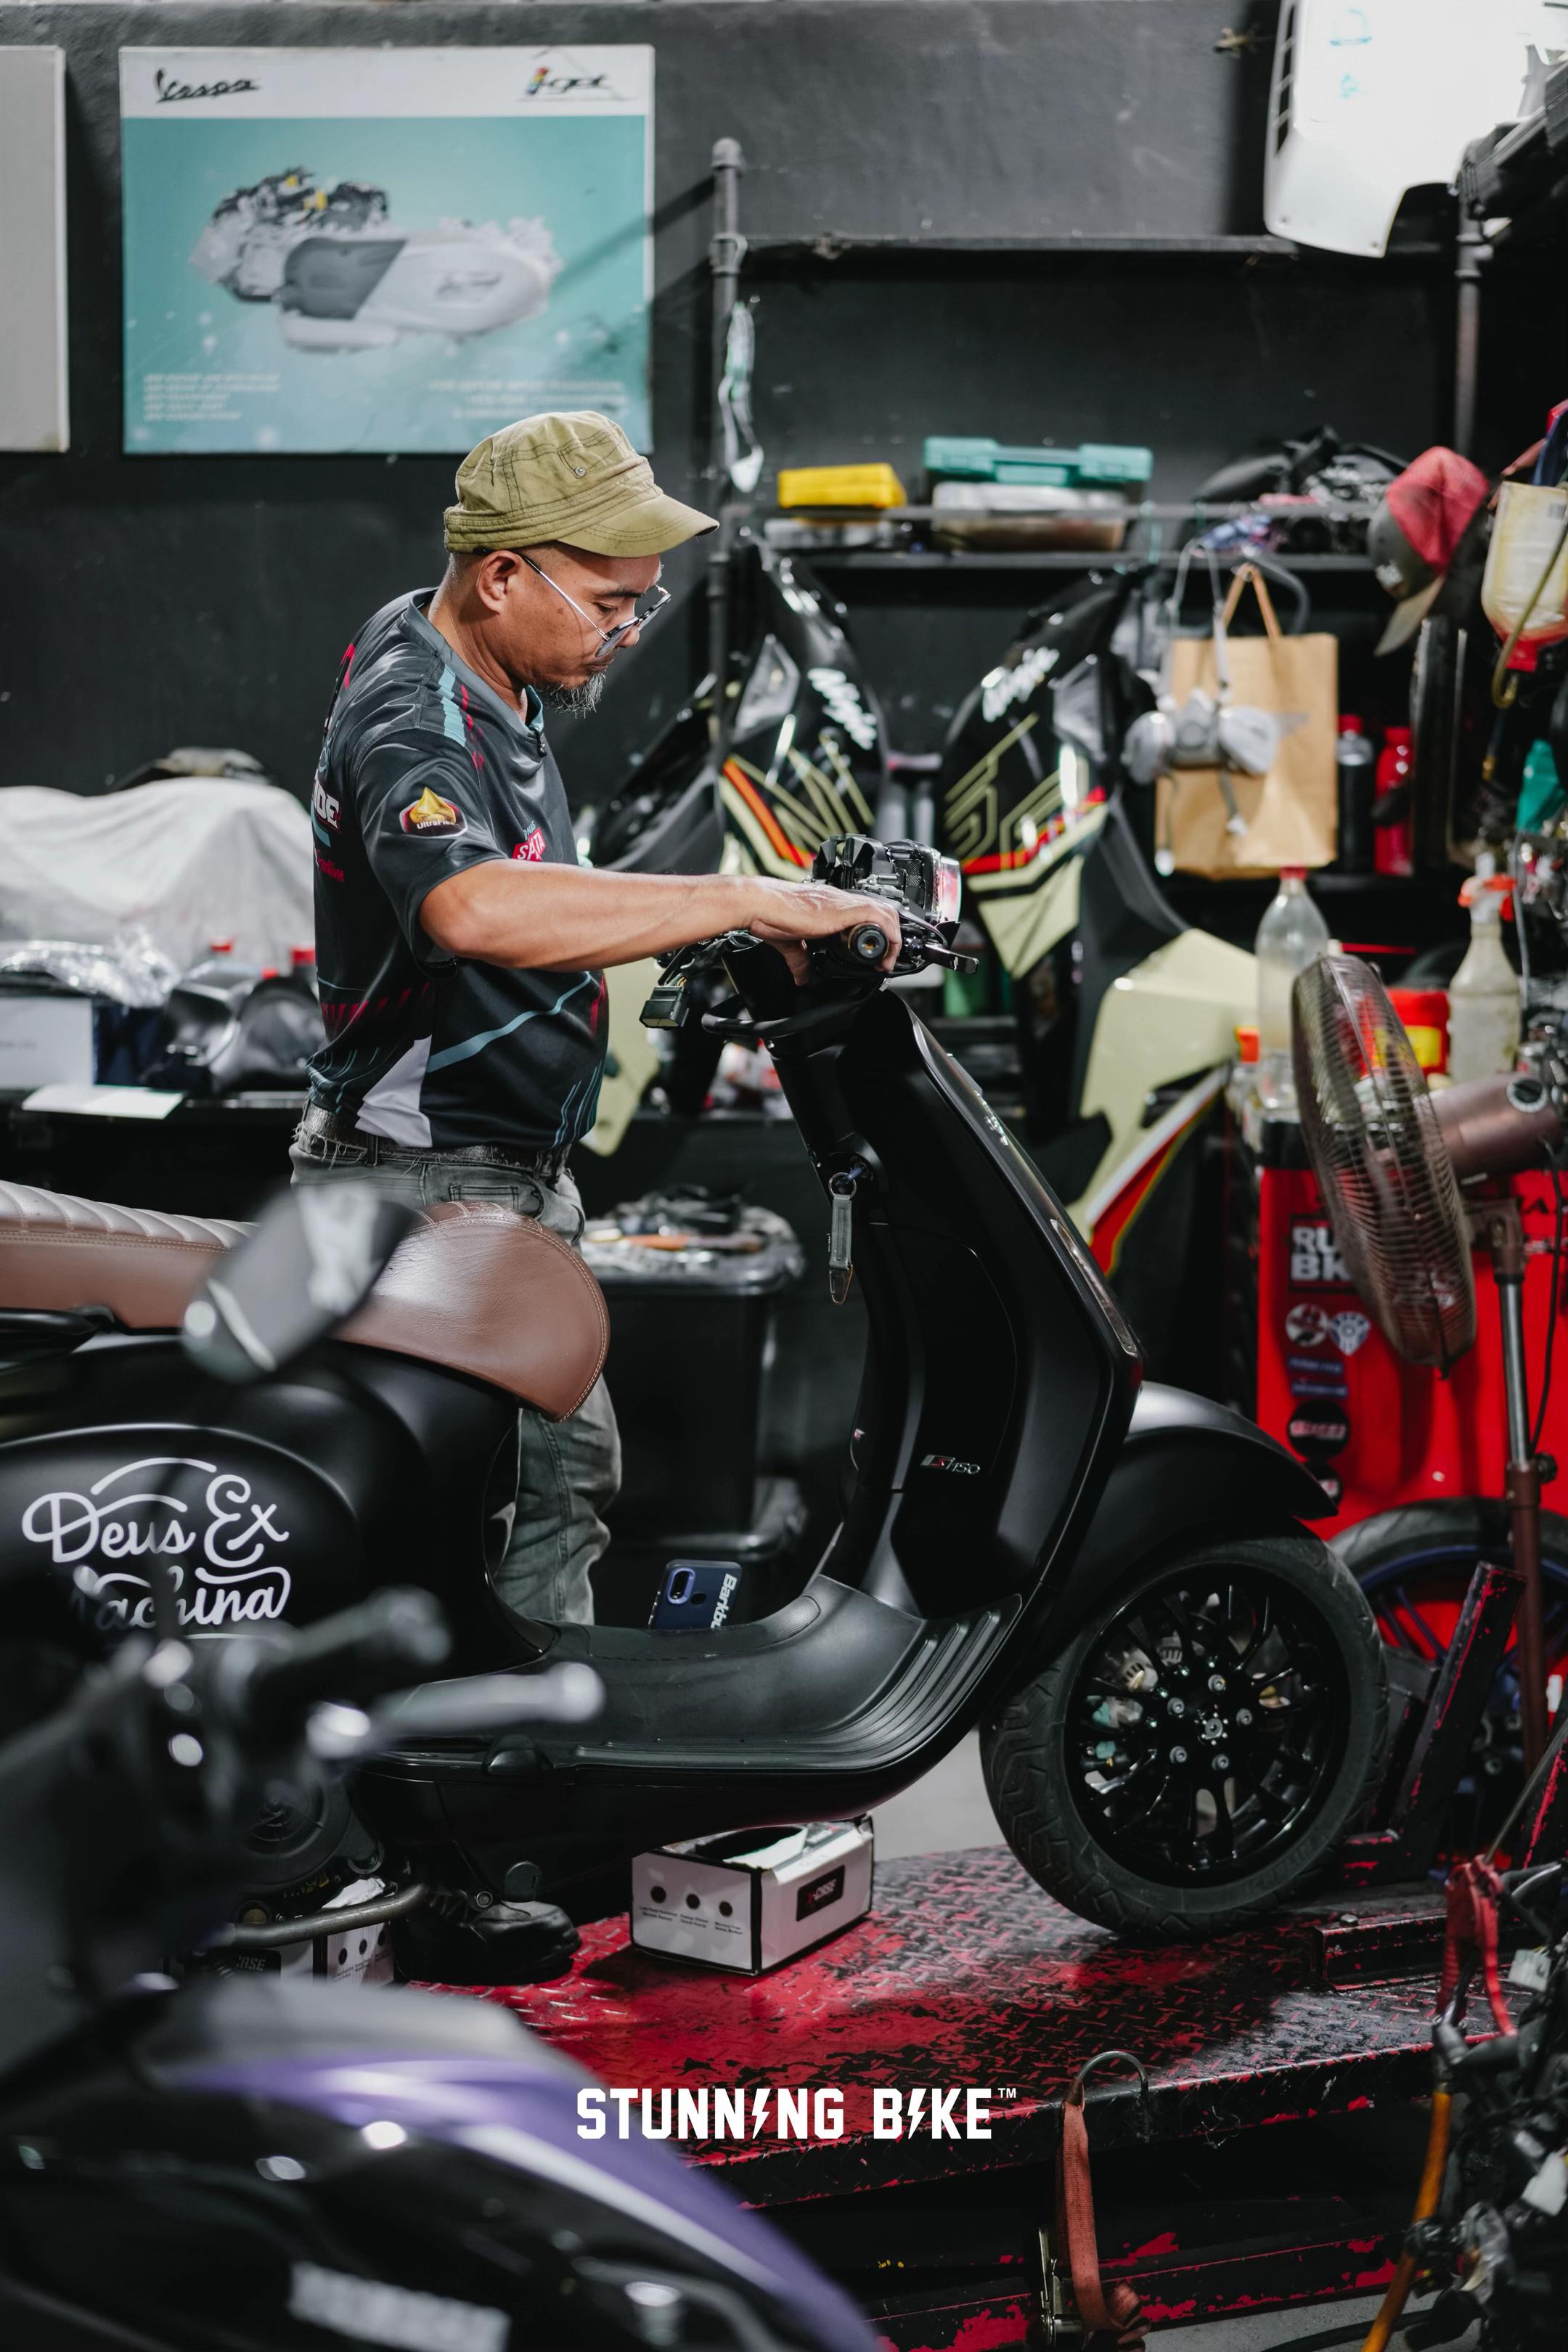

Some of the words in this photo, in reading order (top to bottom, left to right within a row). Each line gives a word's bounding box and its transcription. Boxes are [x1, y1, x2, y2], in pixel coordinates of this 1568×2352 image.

[156, 69, 260, 103] Vespa
[22, 1492, 197, 1563] Deus
[204, 1474, 289, 1568] Ex
